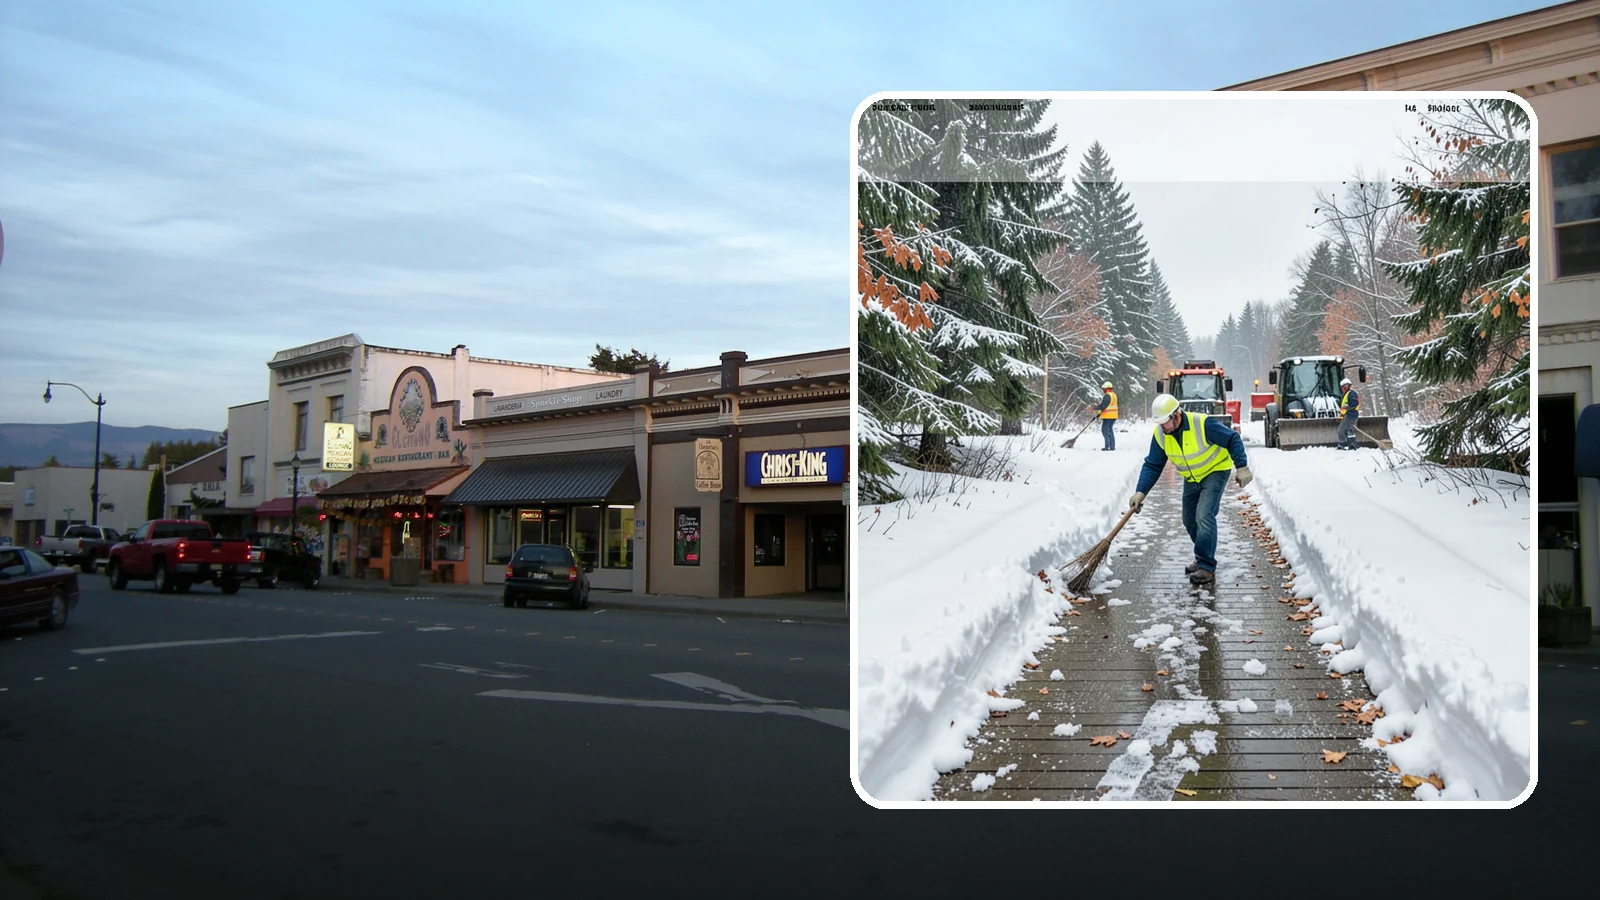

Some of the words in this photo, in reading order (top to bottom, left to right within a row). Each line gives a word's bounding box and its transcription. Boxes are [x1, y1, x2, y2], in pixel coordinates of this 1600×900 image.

[595, 389, 624, 400] LAUNDRY
[493, 402, 523, 412] LAVANDERIA
[530, 396, 560, 409] Sparkle
[561, 394, 583, 405] Shop
[373, 455, 396, 464] MEXICAN
[397, 452, 433, 462] RESTAURANT
[437, 451, 450, 459] BAR
[799, 450, 828, 476] KING
